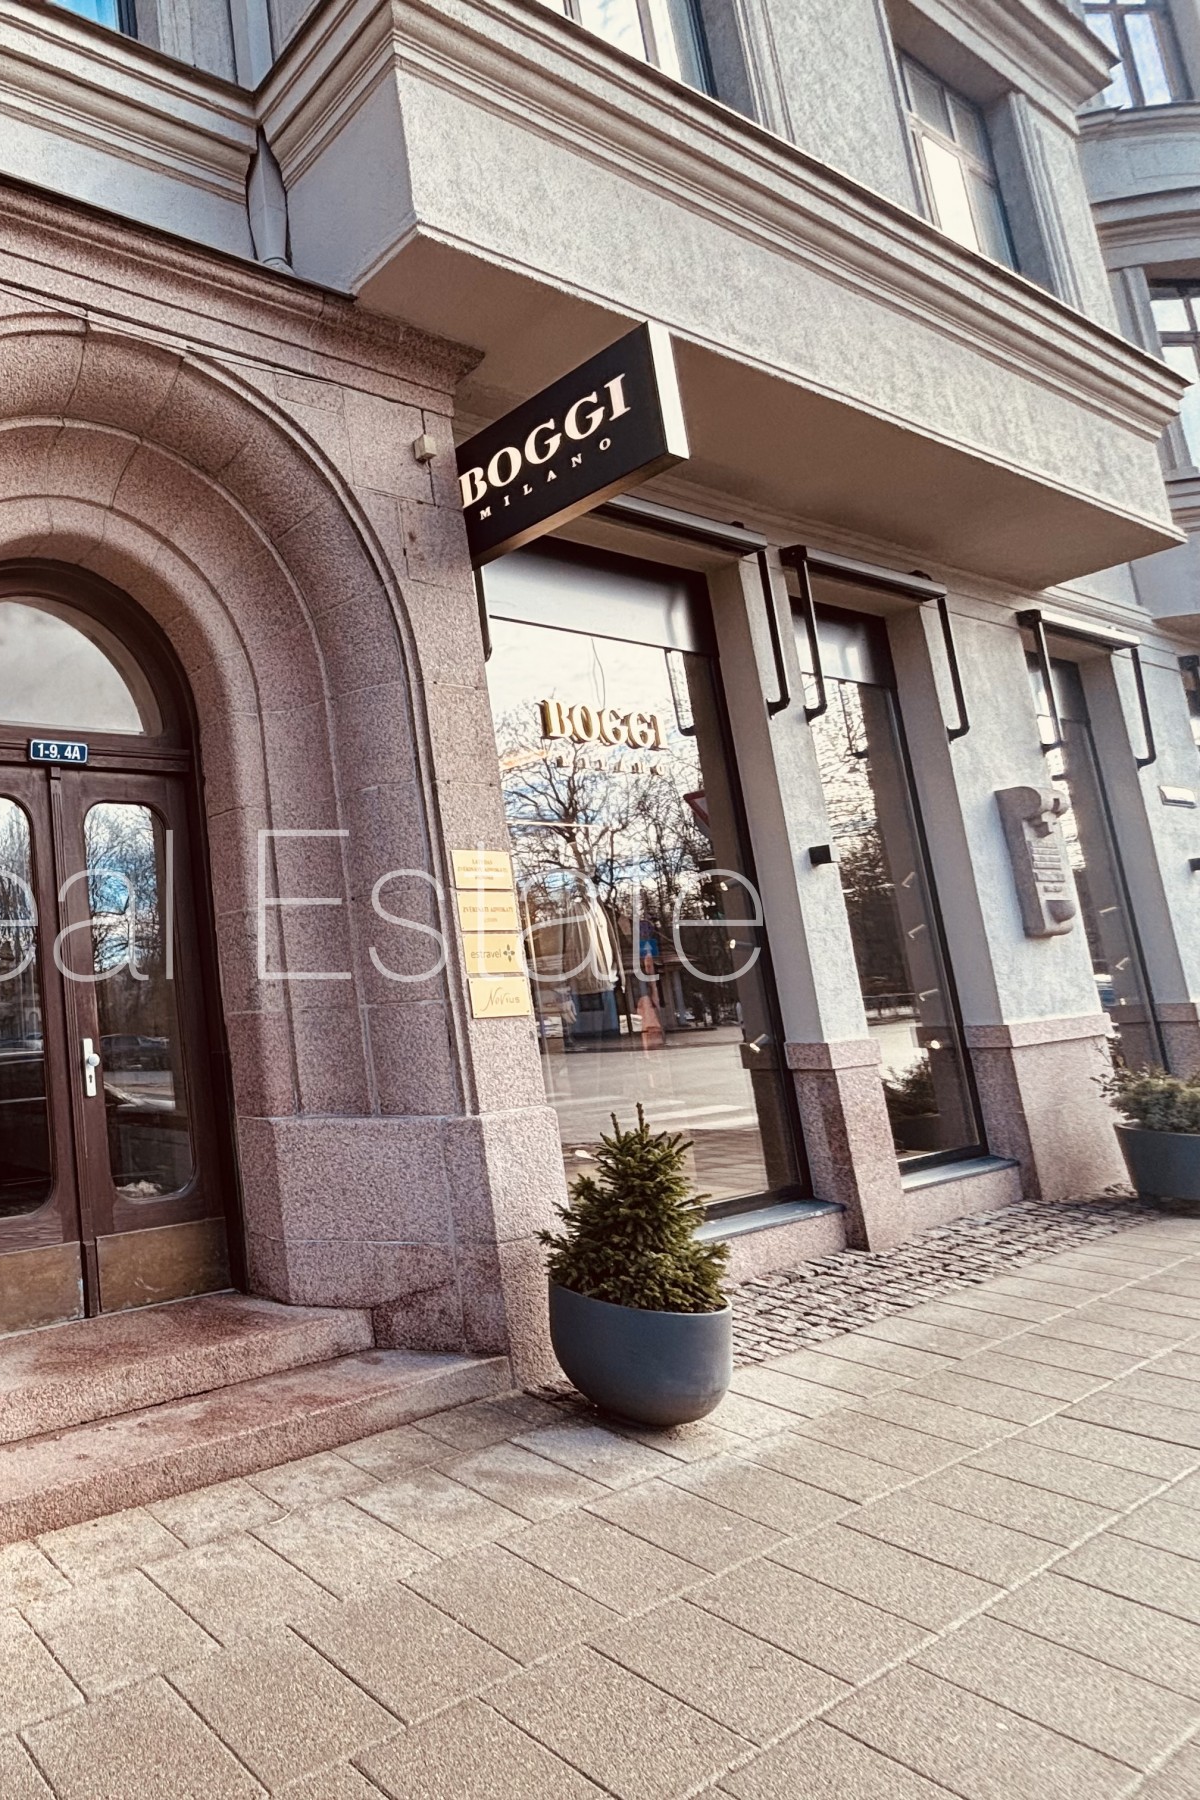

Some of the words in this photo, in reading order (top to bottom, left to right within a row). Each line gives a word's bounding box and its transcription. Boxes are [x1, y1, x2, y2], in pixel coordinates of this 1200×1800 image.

[458, 373, 632, 509] BOGGI
[479, 438, 612, 521] MILANO
[535, 699, 669, 750] BOGGI
[37, 743, 61, 759] 1-9,
[64, 745, 81, 760] 4A
[470, 948, 502, 959] estravel
